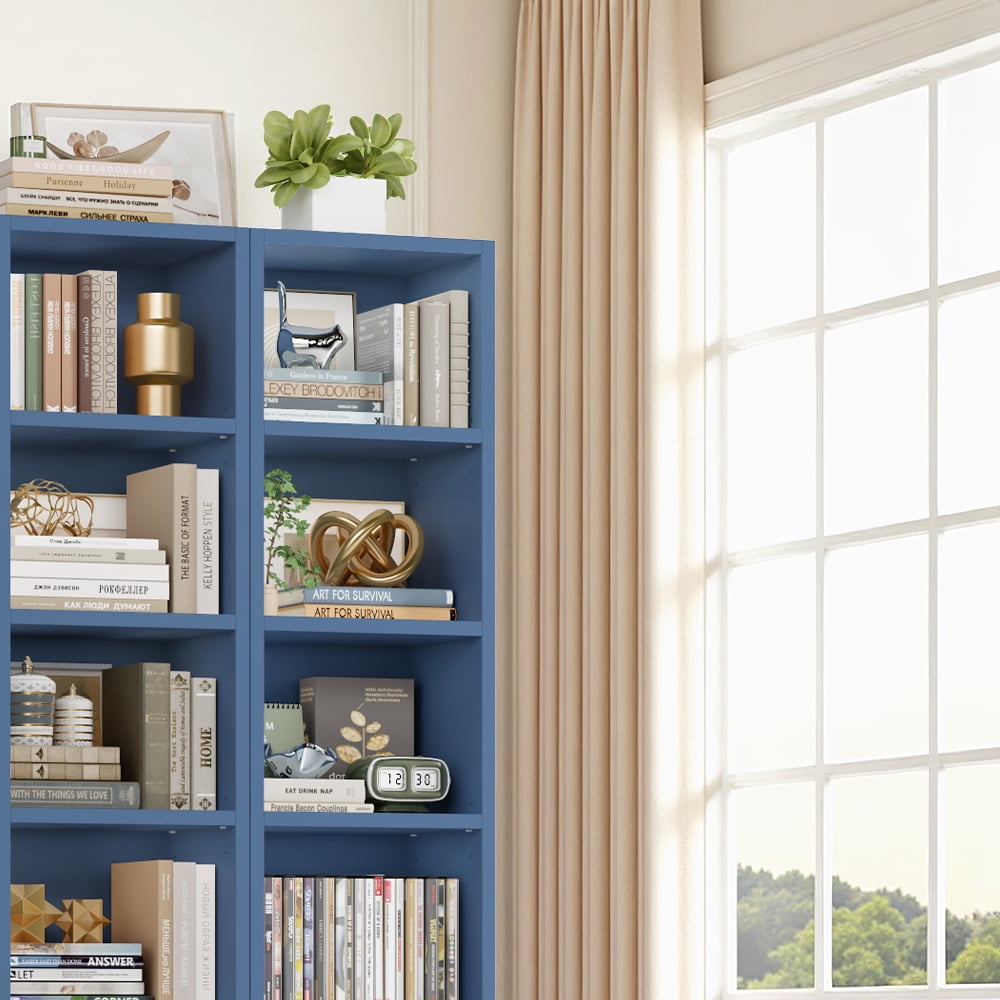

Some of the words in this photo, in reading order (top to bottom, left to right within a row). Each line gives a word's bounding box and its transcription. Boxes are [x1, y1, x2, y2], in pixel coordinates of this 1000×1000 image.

[46, 177, 84, 186] Purienne
[104, 180, 136, 190] Holiday
[80, 212, 117, 221] СИЛЬНЕЕ
[290, 371, 316, 380] Gardens
[325, 372, 348, 381] France
[302, 384, 375, 398] BRODOVITCH
[181, 495, 189, 531] FORMAT
[203, 502, 213, 528] STYLE
[202, 529, 213, 561] HOPPEN
[181, 542, 189, 563] BASIC
[181, 565, 189, 580] THE
[203, 562, 213, 590] KELLY
[99, 584, 149, 595] РОКФЕЛЛЕР
[312, 589, 329, 600] ART
[332, 589, 350, 601] FOR
[352, 590, 393, 602] SURVIVAL
[64, 601, 81, 609] КАК
[314, 607, 332, 618] ART
[334, 608, 351, 619] FOR
[355, 608, 395, 620] SURVIVAL
[200, 727, 212, 769] HOME
[387, 773, 402, 785] 12
[416, 774, 431, 786] 30
[11, 790, 29, 798] WITH
[33, 790, 46, 799] THE
[48, 790, 75, 799] THINGS
[77, 791, 88, 799] WE
[89, 791, 108, 800] LOVE
[270, 804, 294, 812] Francis
[202, 883, 211, 918] НОВЫЙ
[202, 921, 211, 951] ОБРАЗ
[17, 970, 34, 979] LET
[202, 954, 211, 991] ЖИЗНИ
[161, 967, 170, 995] ЛУЧШЕ
